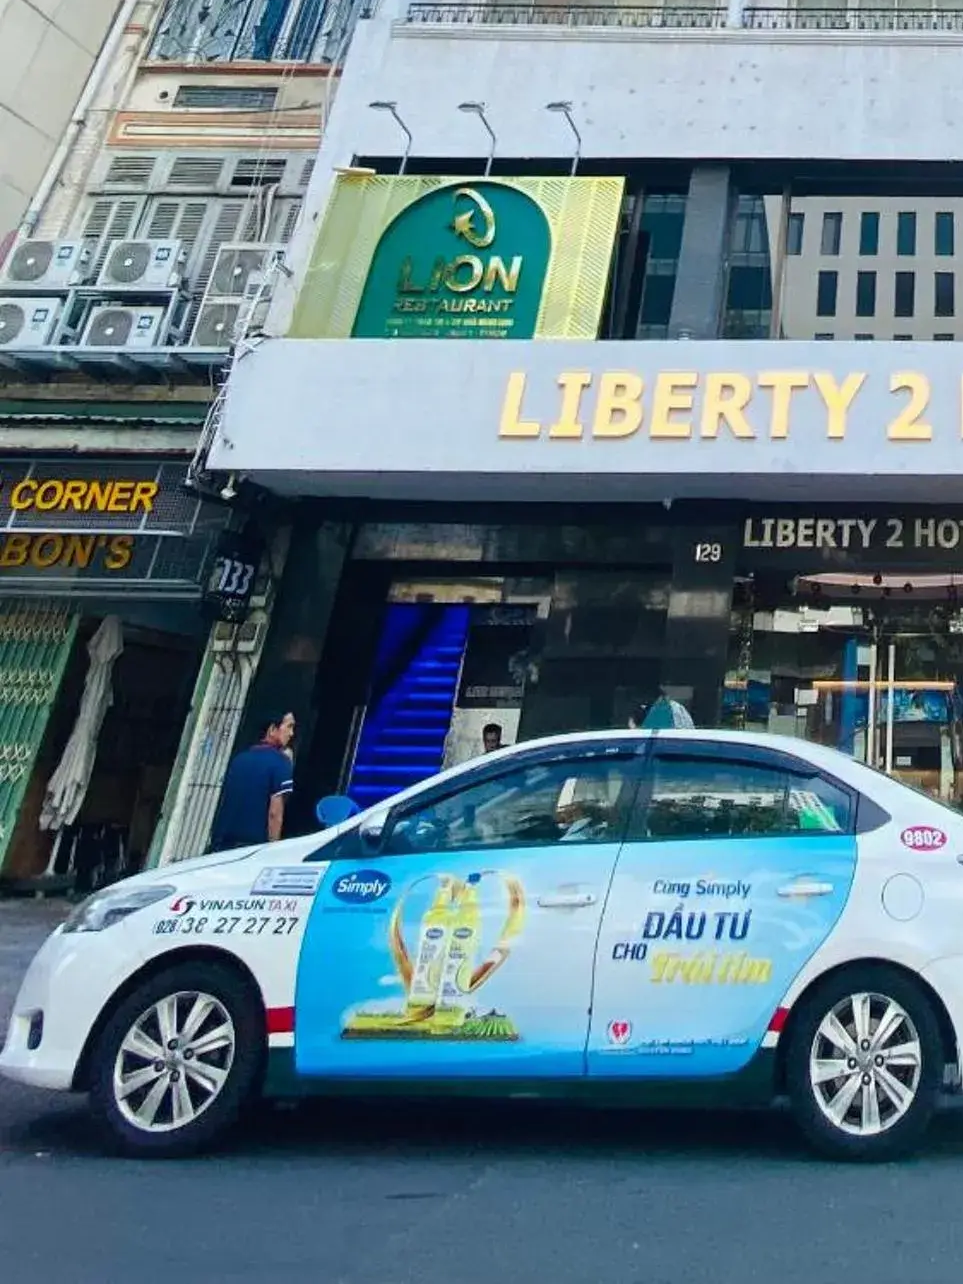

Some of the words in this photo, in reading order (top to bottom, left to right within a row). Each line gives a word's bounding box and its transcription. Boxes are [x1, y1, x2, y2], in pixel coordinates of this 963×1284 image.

[397, 255, 523, 294] LION
[498, 370, 867, 440] LIBERTY
[886, 371, 933, 441] 2
[10, 478, 159, 512] CORNER
[743, 519, 878, 549] LIBERTY
[885, 519, 905, 548] 2
[695, 542, 722, 563] 129
[903, 829, 943, 847] 9802
[336, 874, 388, 898] Simply
[696, 879, 752, 900] Simply
[200, 899, 266, 911] VINASUN
[267, 900, 298, 912] TAXI
[213, 917, 241, 935] 27
[243, 917, 271, 935] 27
[272, 917, 300, 935] 27
[612, 942, 648, 961] CHO
